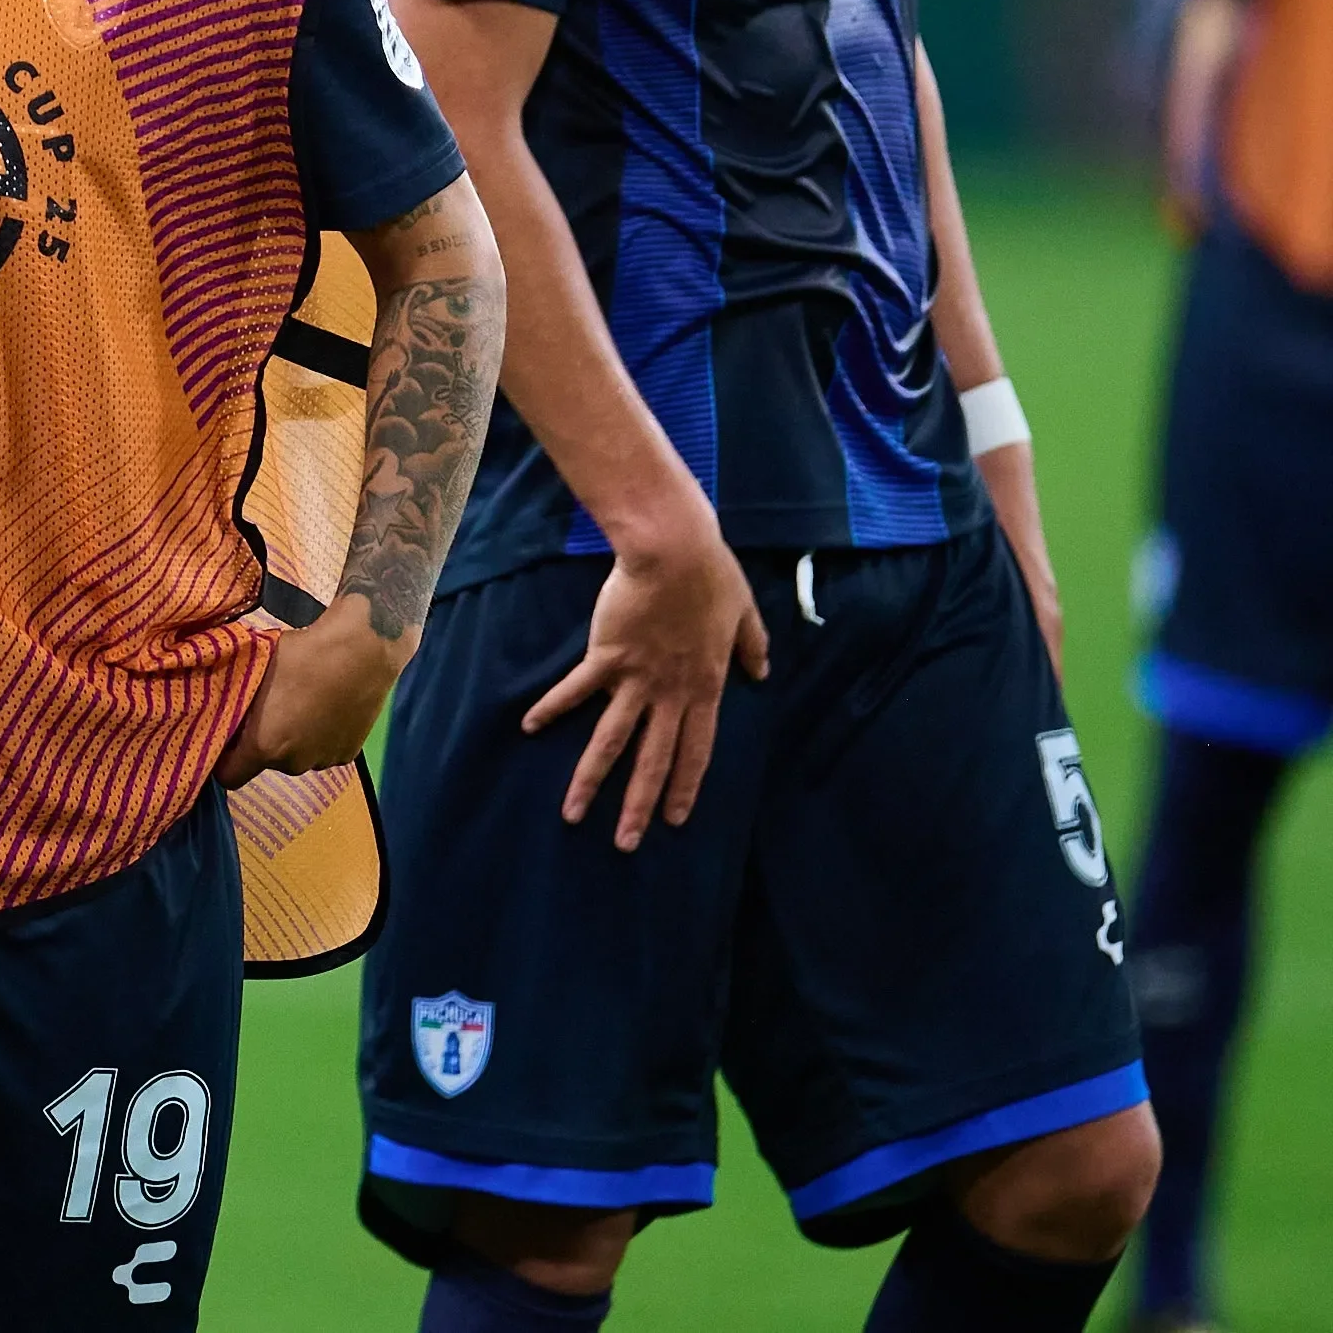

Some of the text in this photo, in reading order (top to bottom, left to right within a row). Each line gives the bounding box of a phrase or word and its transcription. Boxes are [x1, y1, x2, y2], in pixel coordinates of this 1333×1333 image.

[4, 60, 76, 163] CUP
[37, 195, 78, 264] 25
[1035, 727, 1108, 888] 5
[42, 1067, 211, 1230] 19
